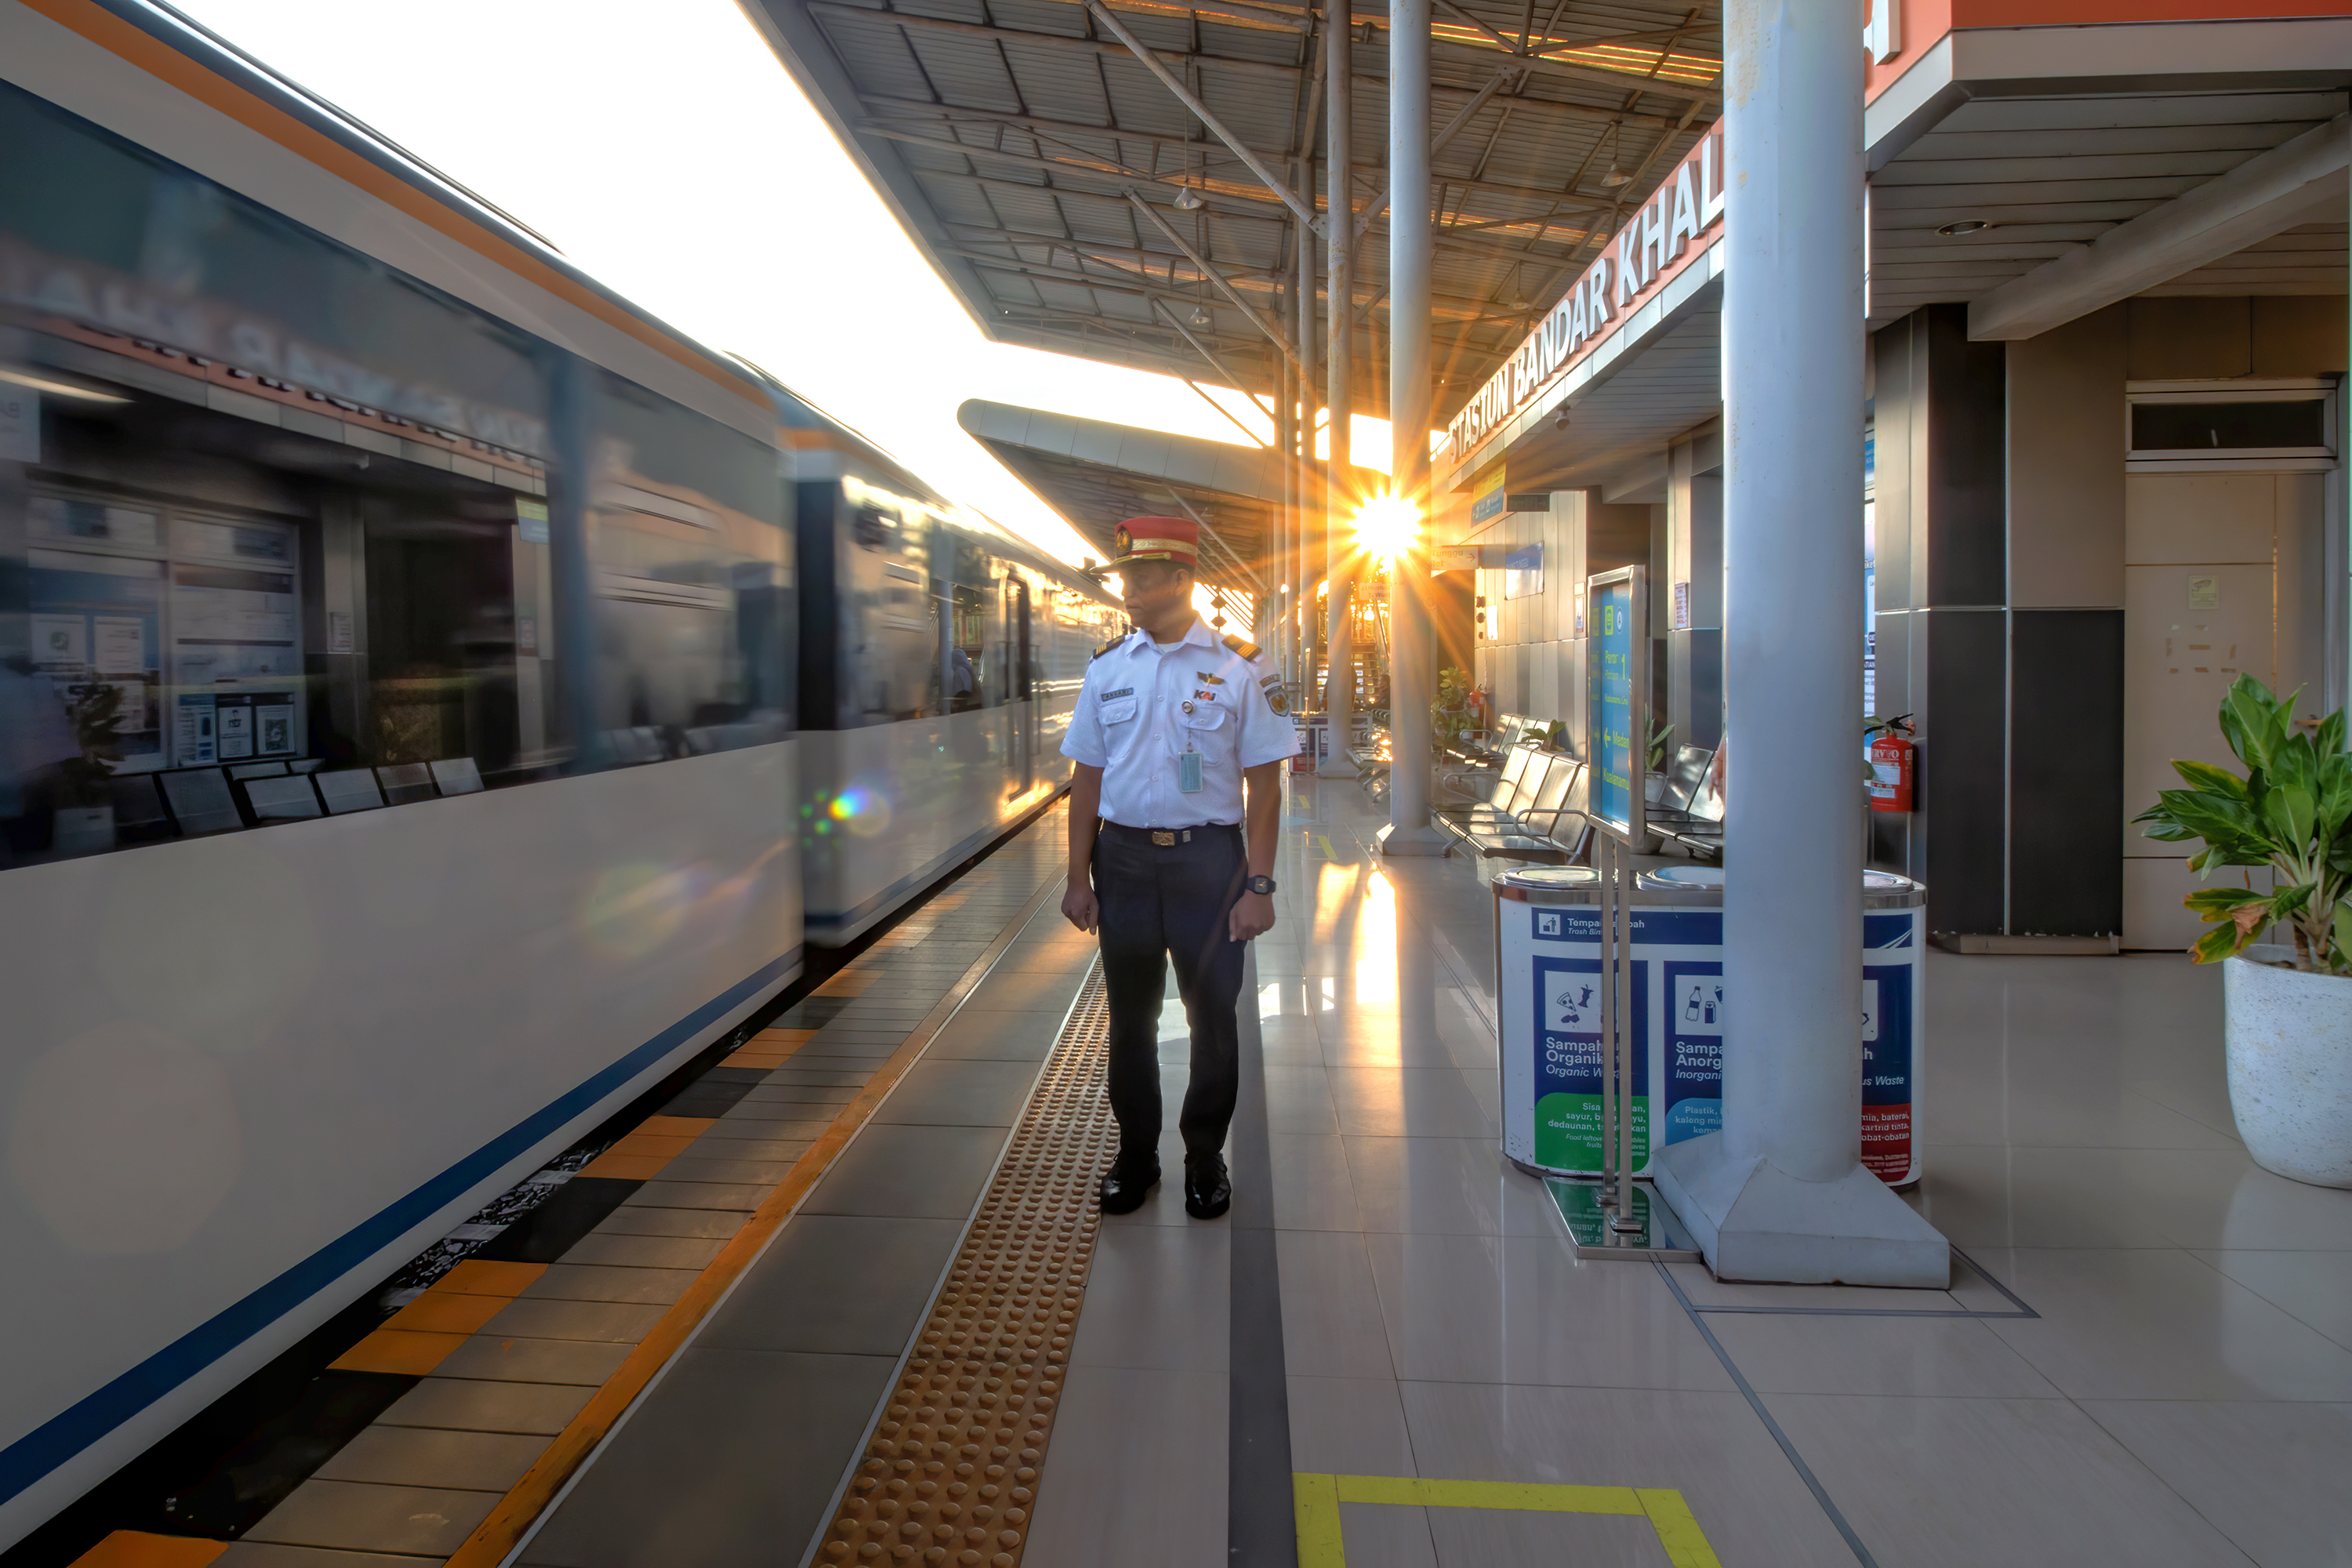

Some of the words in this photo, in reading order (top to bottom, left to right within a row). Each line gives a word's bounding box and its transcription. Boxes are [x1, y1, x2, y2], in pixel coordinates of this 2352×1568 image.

[1450, 363, 1514, 464] STASIUN
[1514, 258, 1615, 406] BANDAR
[1546, 1064, 1590, 1078] Organic
[1875, 1076, 1904, 1086] Waste
[1685, 1106, 1718, 1116] Plastik,
[1566, 1112, 1592, 1121] sayur,
[1548, 1119, 1595, 1131] dedaunan,
[1861, 1132, 1910, 1141] obat-obatan
